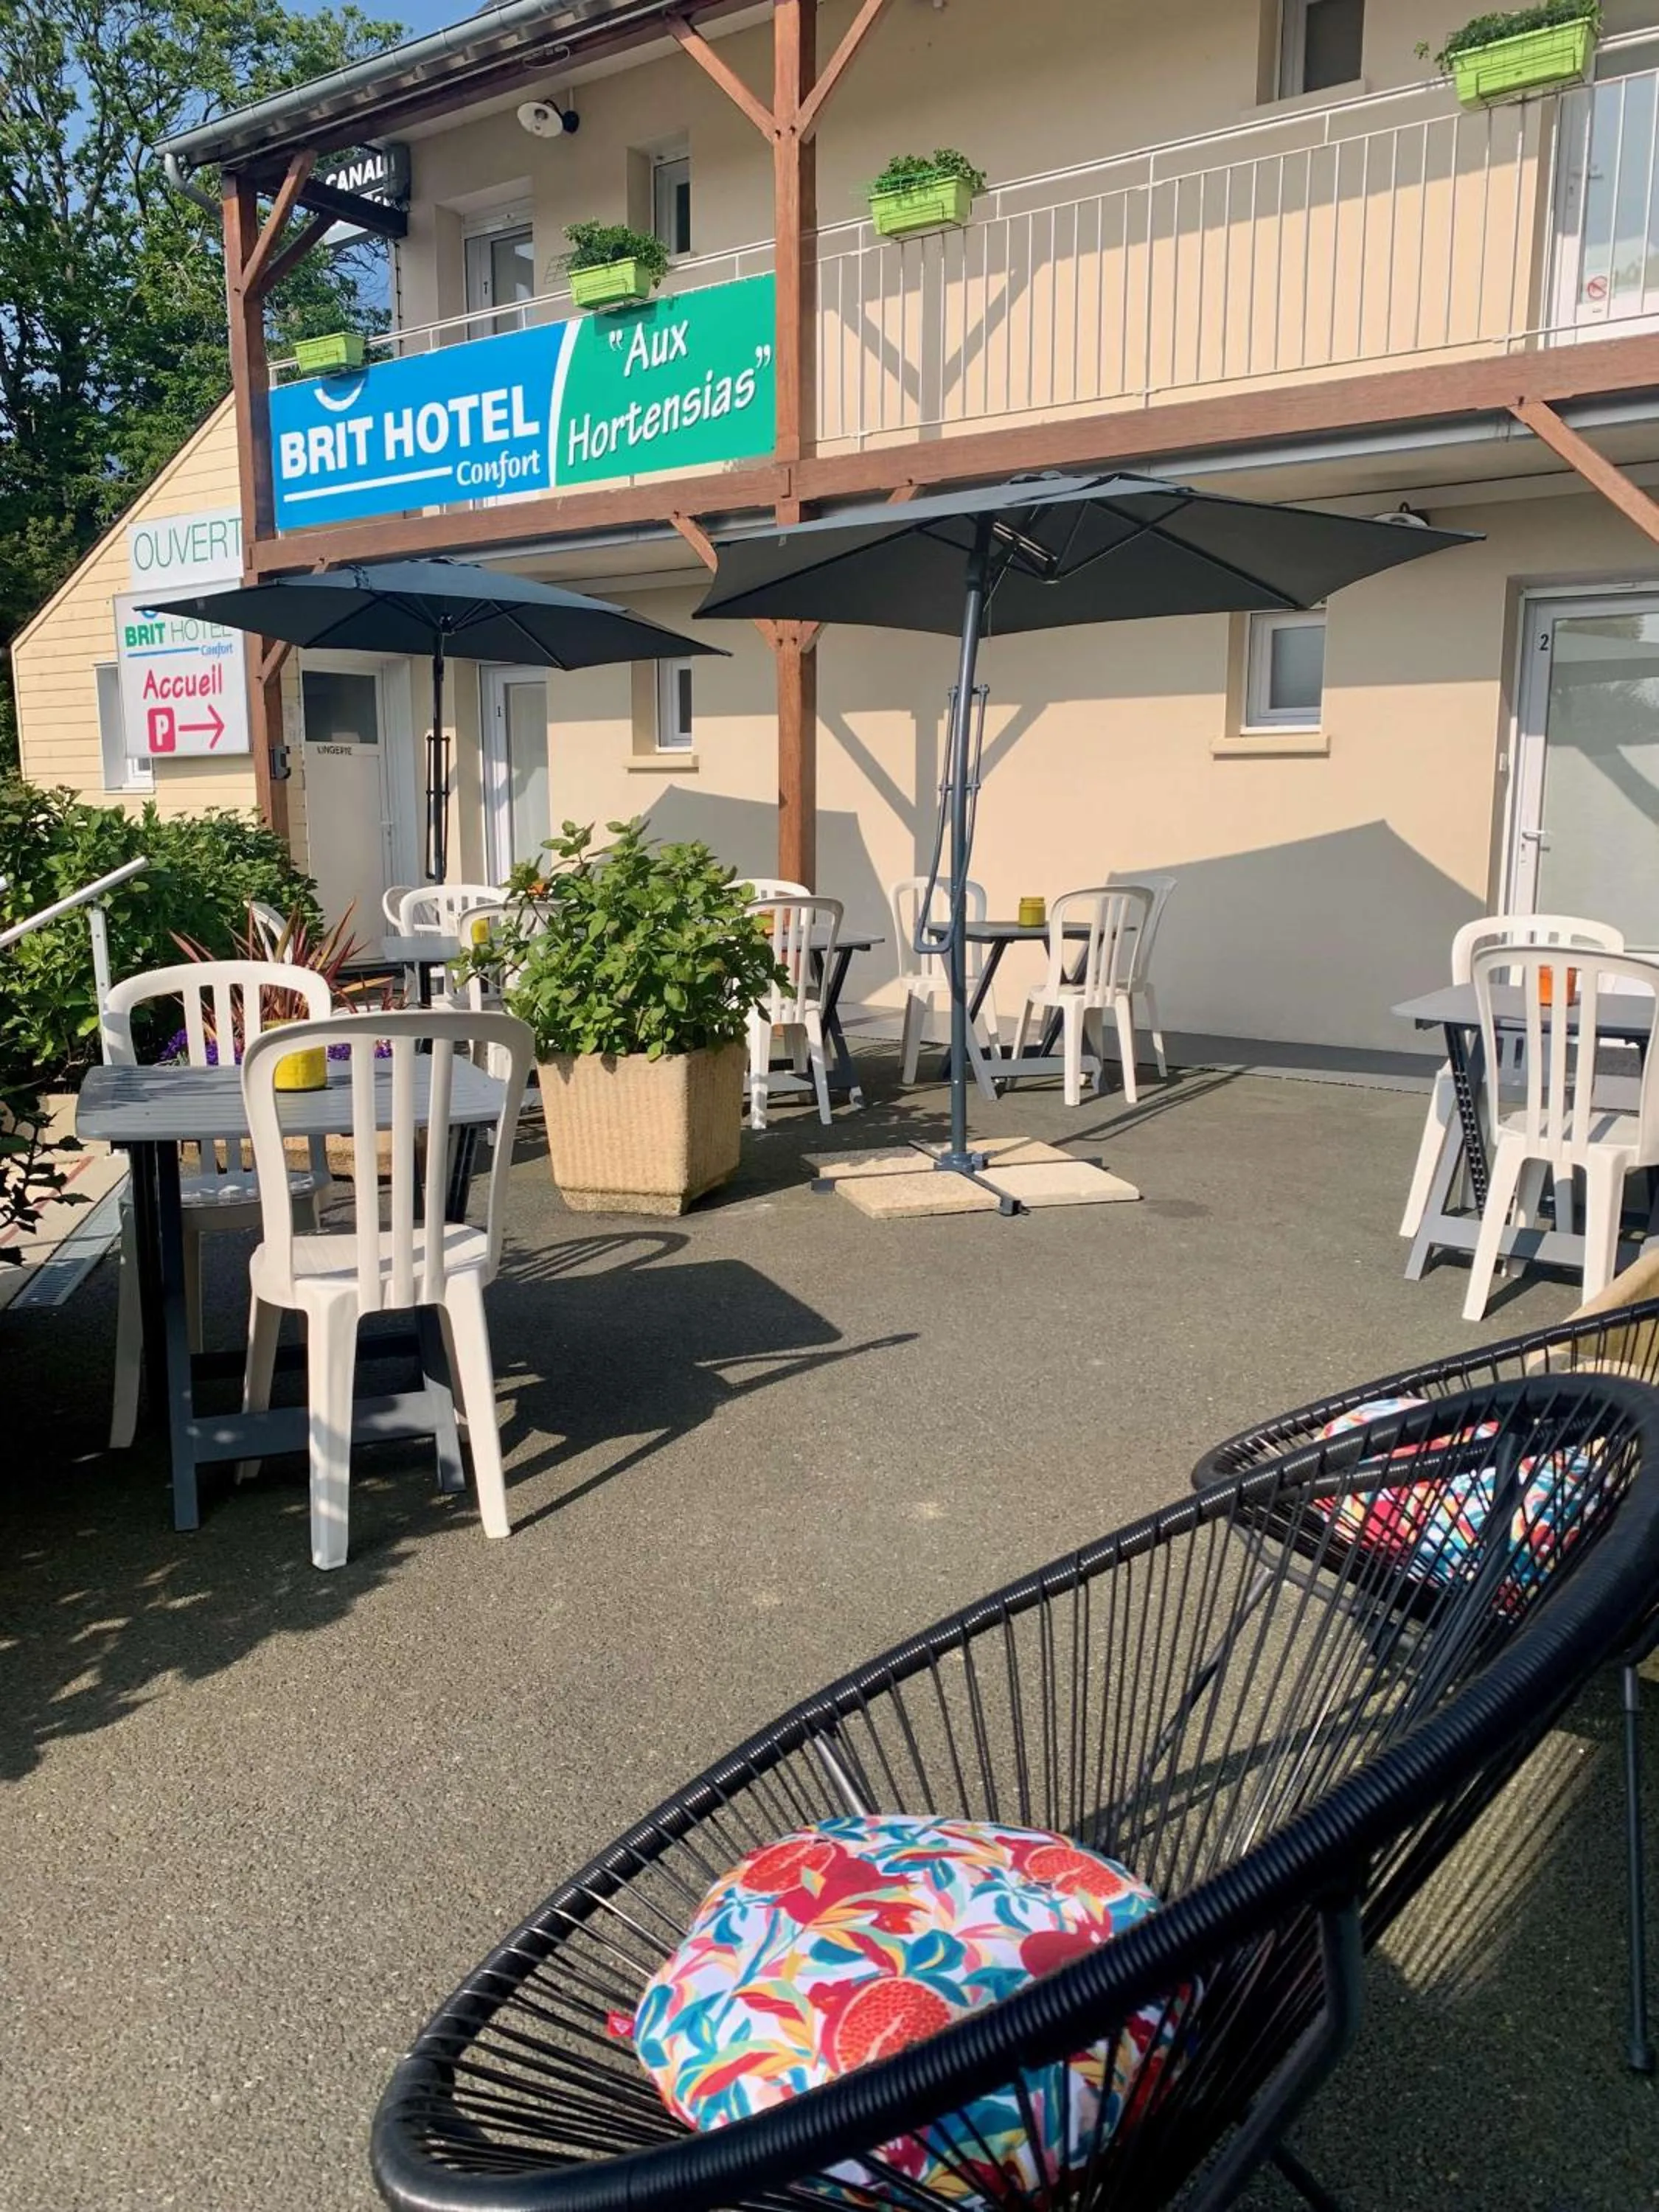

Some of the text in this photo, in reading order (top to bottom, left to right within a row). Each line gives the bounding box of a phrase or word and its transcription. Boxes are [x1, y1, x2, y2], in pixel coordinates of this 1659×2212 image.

[280, 385, 540, 479] BRIT HOTEL
[456, 449, 541, 489] Confort
[133, 518, 242, 571] OUVERT
[125, 622, 165, 647] BRIT
[201, 641, 234, 658] Confort
[1540, 633, 1549, 651] 2
[143, 663, 222, 700] Accueil
[155, 714, 170, 746] P
